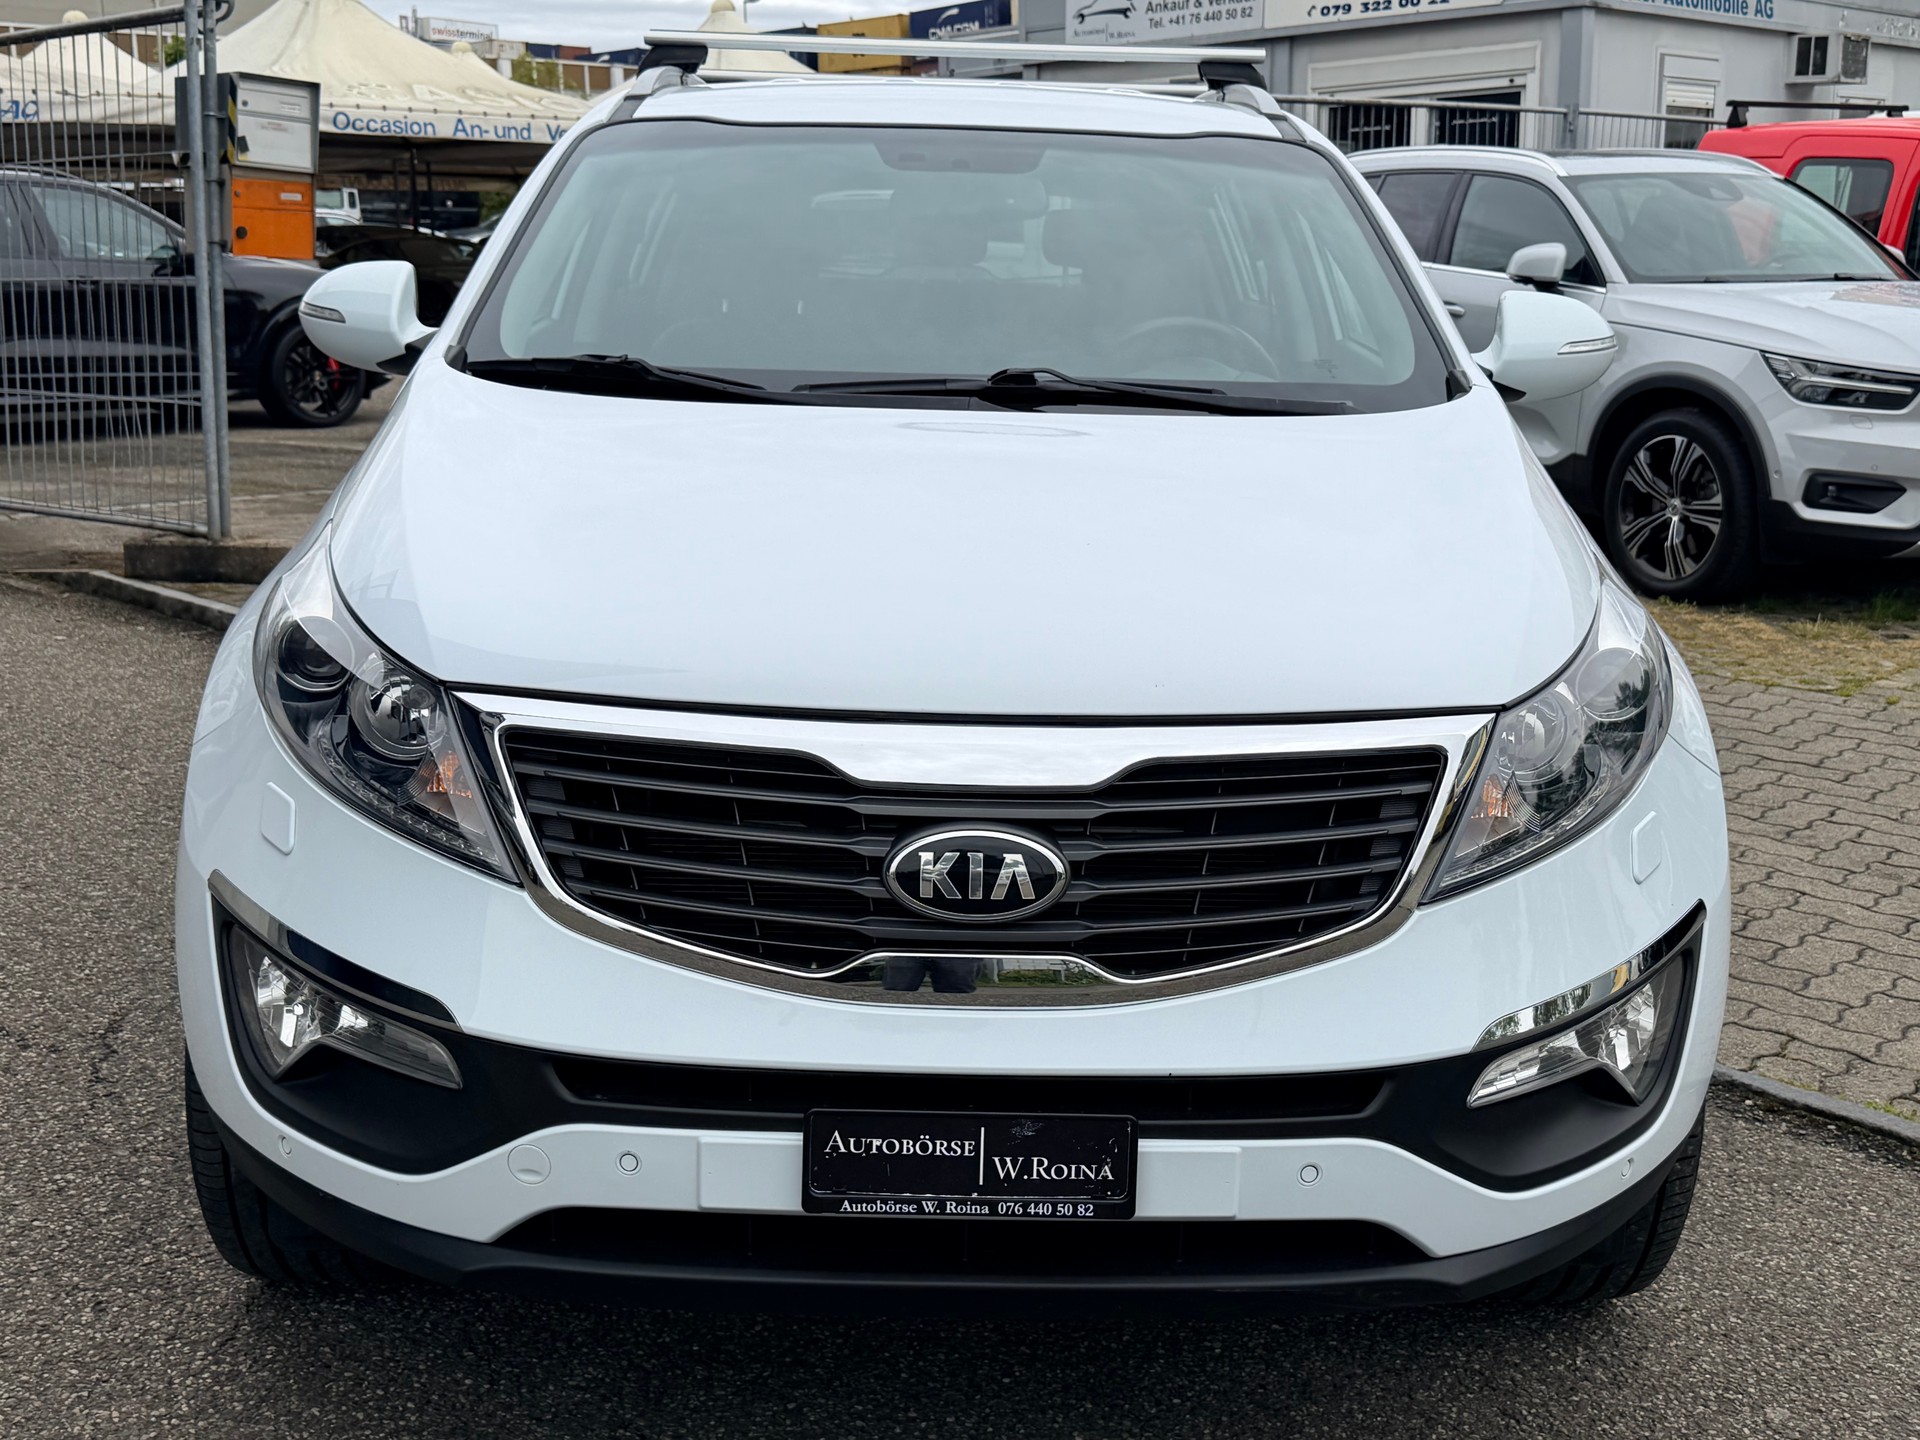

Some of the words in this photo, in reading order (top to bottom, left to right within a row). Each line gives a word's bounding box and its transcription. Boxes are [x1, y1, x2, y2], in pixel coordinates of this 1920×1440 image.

[1145, 0, 1190, 14] Ankauf
[1320, 4, 1352, 17] 079
[1360, 0, 1392, 14] 322
[1664, 0, 1749, 16] Automobile
[1754, 0, 1774, 19] AG
[1148, 17, 1166, 30] Tel.
[1168, 14, 1187, 26] +41
[1189, 13, 1202, 25] 76
[1203, 10, 1223, 22] 440
[1225, 8, 1238, 20] 50
[1240, 6, 1254, 18] 82
[431, 27, 494, 40] swissterminal
[332, 111, 437, 137] Occasion
[918, 851, 1036, 900] KIA
[824, 1130, 976, 1157] AUTOBÖRSE
[840, 1199, 918, 1214] Autobörse
[921, 1200, 941, 1215] W.
[945, 1201, 990, 1215] Roina
[998, 1202, 1024, 1216] 076
[1027, 1202, 1053, 1216] 440
[1056, 1203, 1074, 1217] 50
[1077, 1203, 1095, 1217] 82
